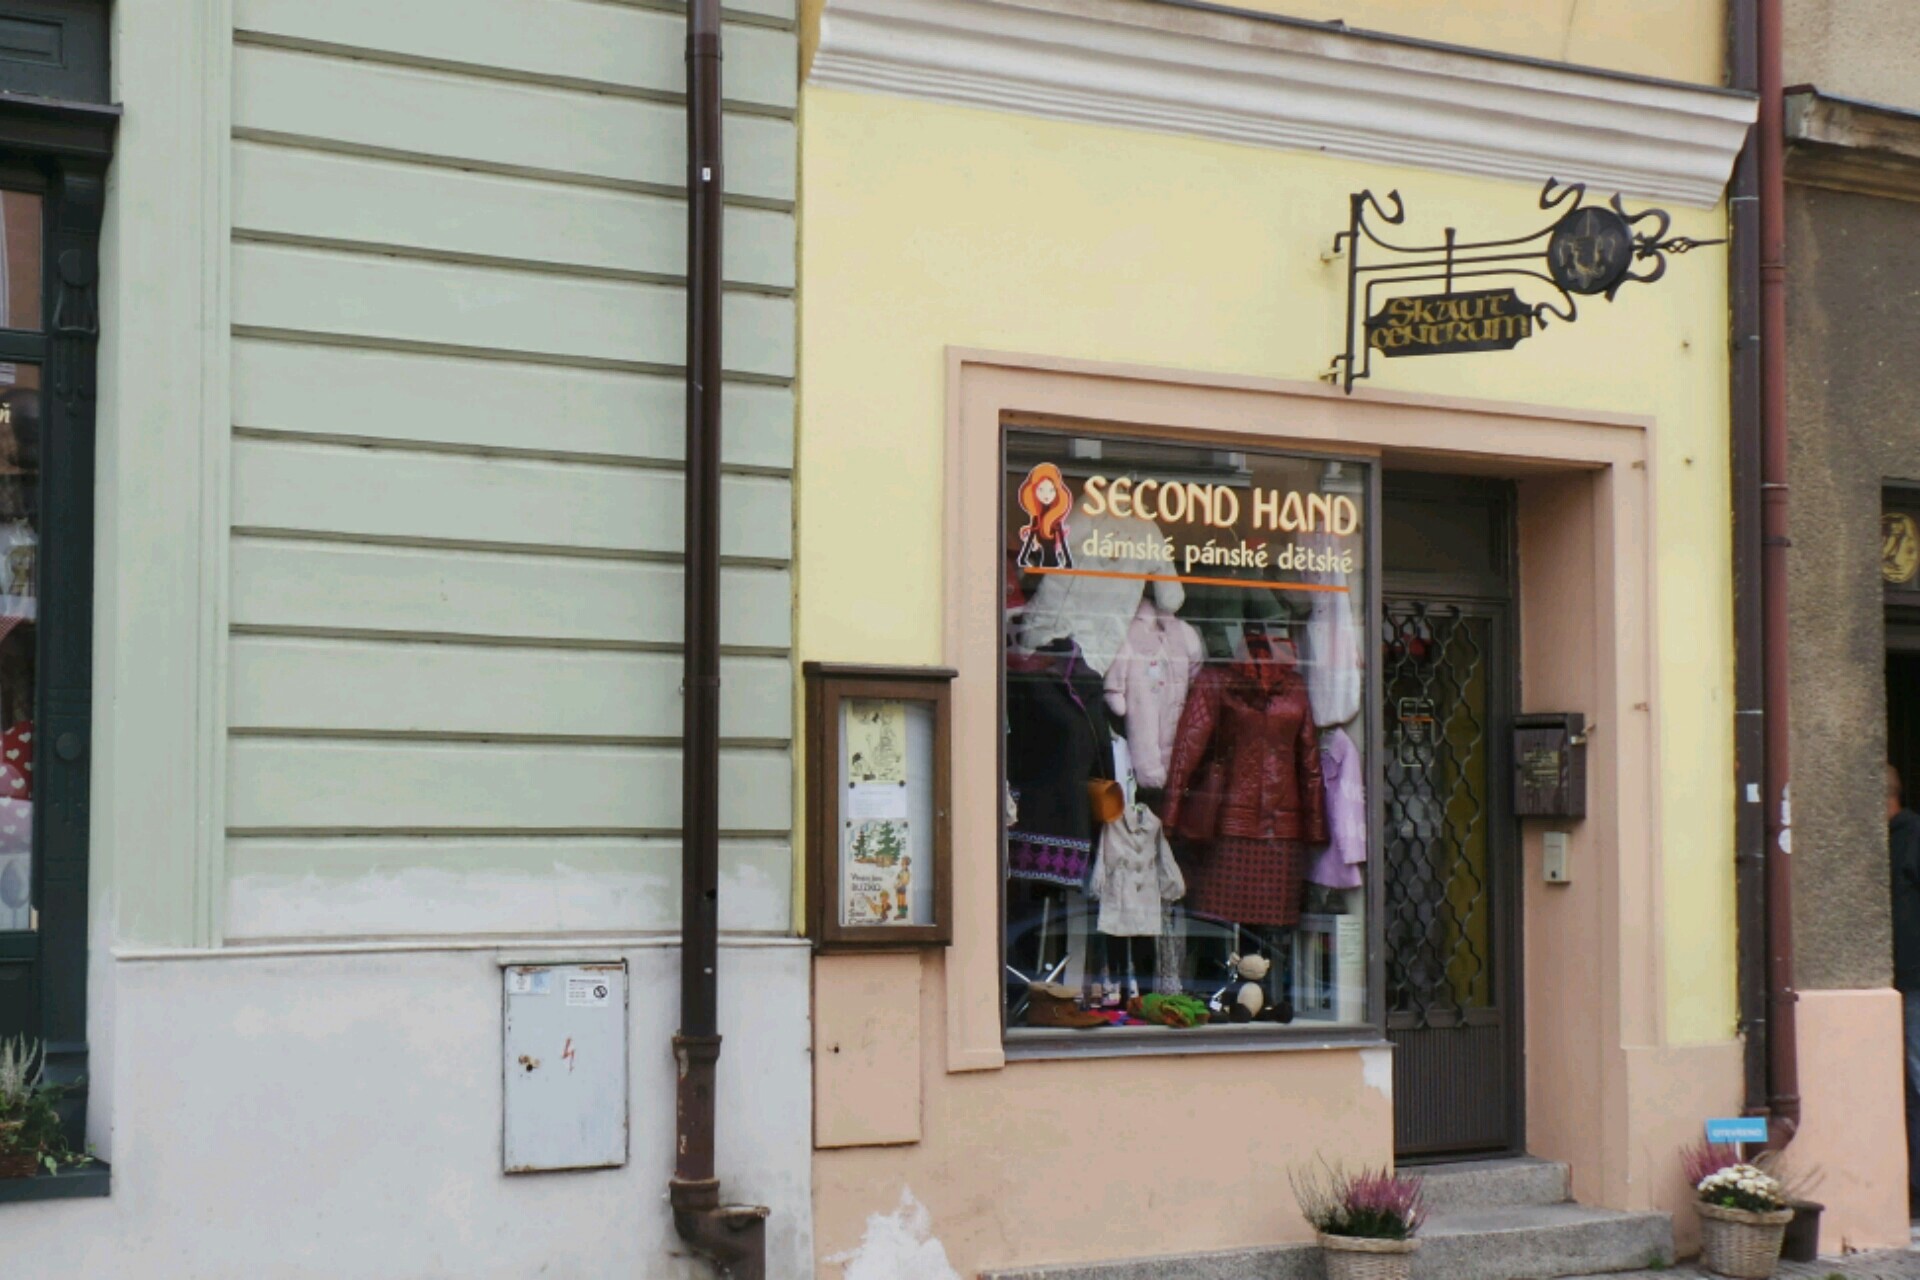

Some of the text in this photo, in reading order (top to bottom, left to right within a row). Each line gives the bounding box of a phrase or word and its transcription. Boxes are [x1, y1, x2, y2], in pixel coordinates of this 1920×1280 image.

[1082, 475, 1359, 537] SECOND HAND
[1081, 528, 1354, 574] dámské pánské dětské
